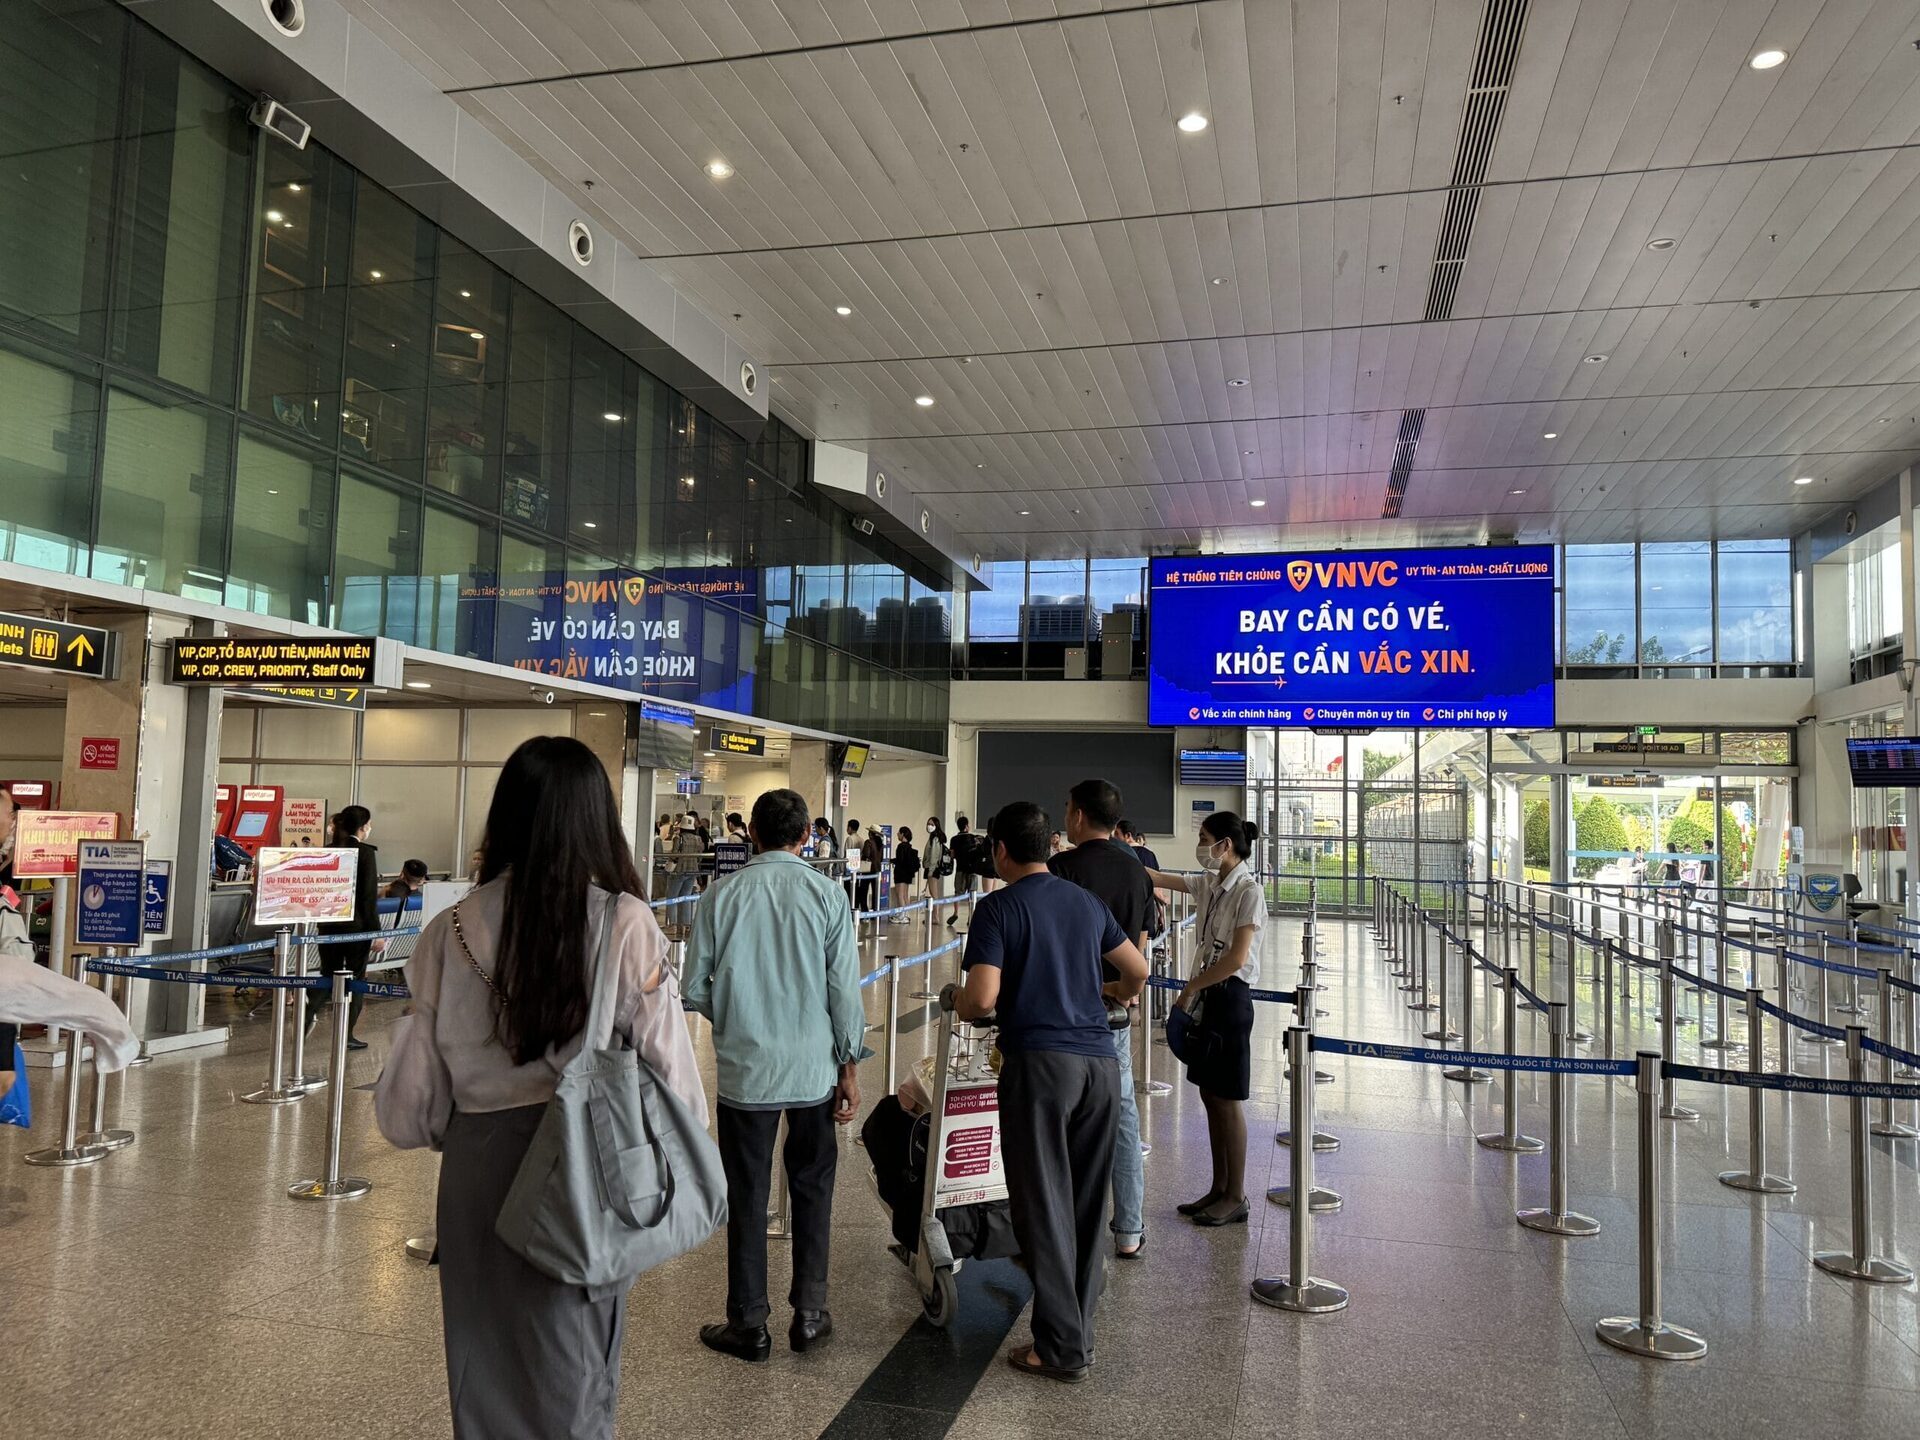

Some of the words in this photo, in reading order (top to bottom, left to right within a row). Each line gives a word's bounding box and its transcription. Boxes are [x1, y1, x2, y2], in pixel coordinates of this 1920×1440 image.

[1314, 561, 1398, 588] VNVC
[1406, 566, 1419, 577] UY
[1515, 563, 1548, 576] LƯỢNG
[1167, 571, 1180, 585] HỆ
[1182, 570, 1216, 582] THỐNG
[1219, 569, 1243, 581] TIÊM
[1240, 609, 1290, 633] BAY
[1297, 599, 1354, 632] CẦN
[1362, 601, 1399, 631] CÓ
[1407, 600, 1450, 631] VÉ,
[343, 643, 371, 659] VIÊN
[1216, 644, 1286, 675] KHỎE
[1293, 642, 1350, 675] CẦN
[1358, 640, 1412, 674] VẮC
[1421, 650, 1476, 673] XIN.
[181, 665, 200, 678] VIP,
[202, 665, 222, 678] CIP,
[224, 665, 258, 678] CREW,
[259, 664, 311, 679] PRIORITY,
[312, 663, 338, 677] Staff
[340, 664, 366, 679] Only
[1202, 707, 1219, 719] Vắc
[1222, 708, 1236, 718] xin
[1239, 708, 1266, 718] chính
[1317, 709, 1354, 721] Chuyên
[1357, 709, 1379, 719] môn
[1381, 711, 1394, 721] uy
[1396, 709, 1410, 719] tín
[1437, 709, 1455, 719] Chi
[1457, 709, 1474, 721] phí
[1476, 709, 1496, 721] hợp
[1498, 709, 1508, 721] lý
[23, 853, 77, 863] RESTRICTE
[85, 846, 110, 858] TIA
[247, 942, 263, 950] TIA
[300, 936, 315, 944] TIA
[164, 971, 185, 981] TIA
[367, 983, 388, 994] TIA
[1344, 1042, 1378, 1057] TIA
[1451, 1053, 1476, 1063] HÀNG
[1478, 1055, 1510, 1066] KHÔNG
[1513, 1057, 1538, 1068] QUỐC
[1554, 1059, 1571, 1069] TÂN
[1574, 1061, 1594, 1070] SƠN
[1698, 1068, 1739, 1085] TIA
[1852, 1083, 1891, 1095] KHÔNG
